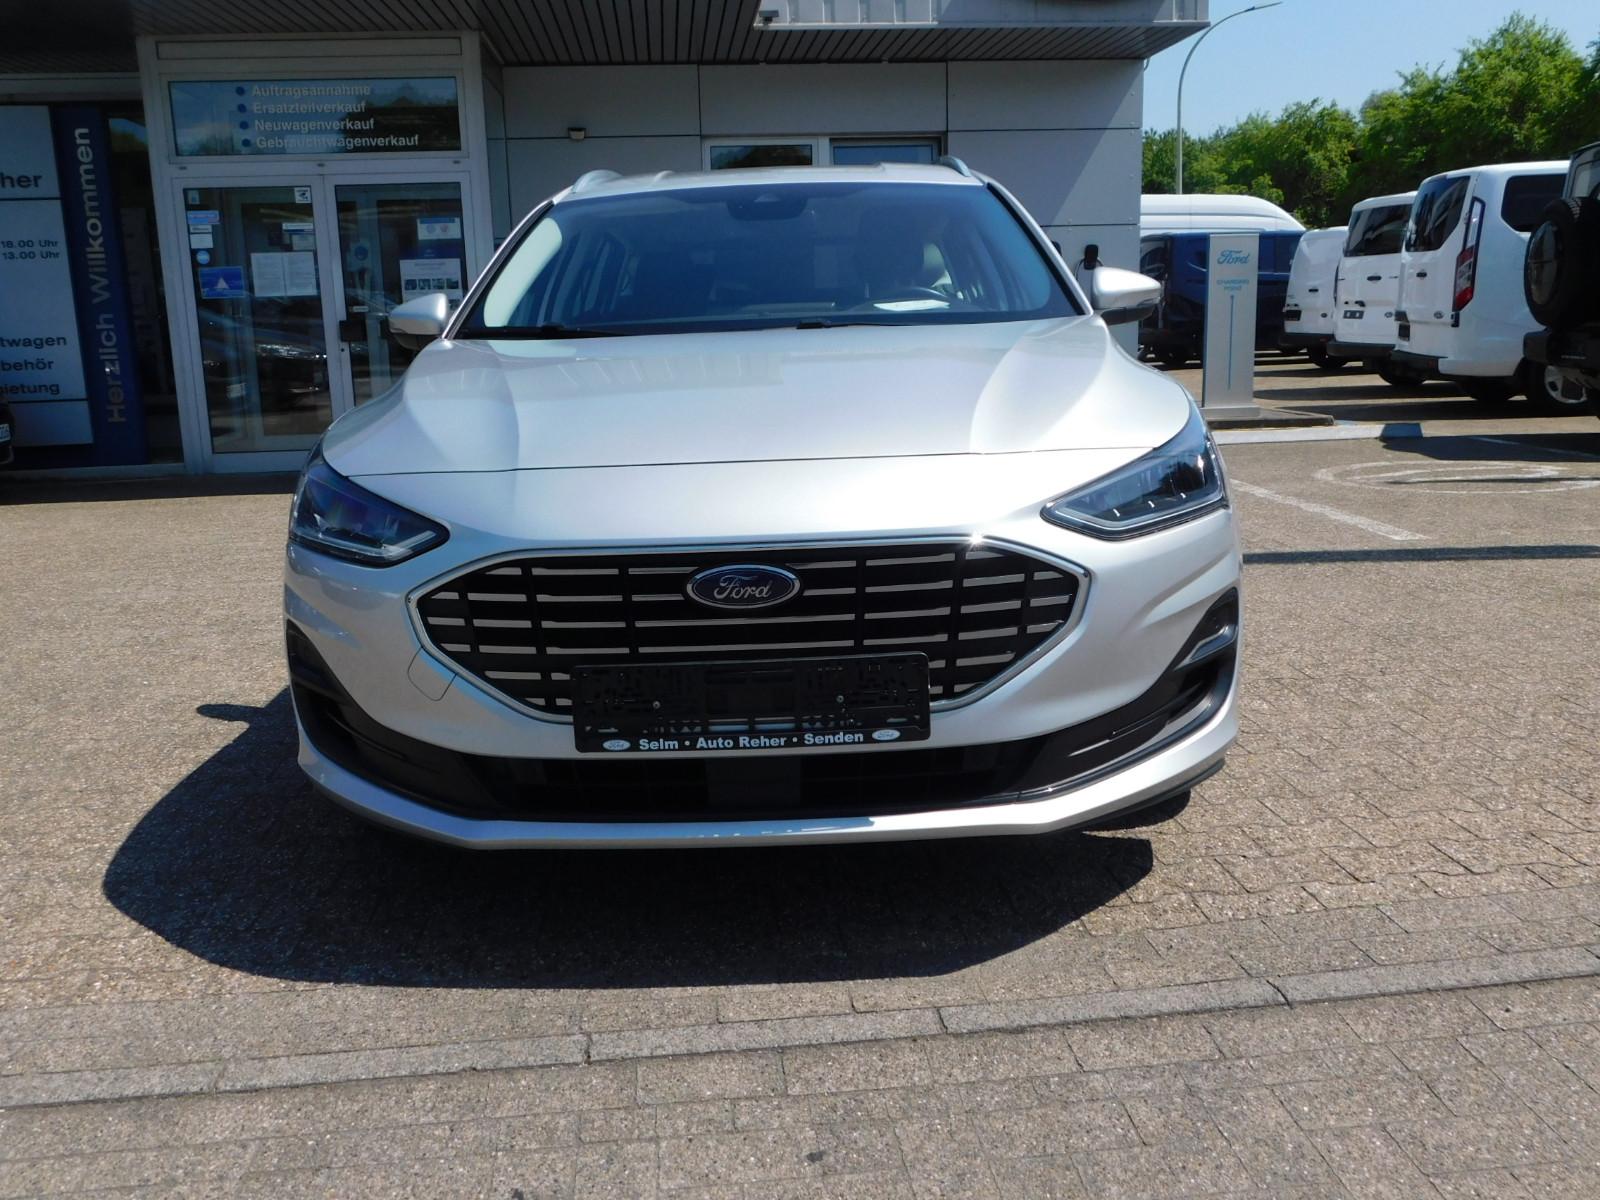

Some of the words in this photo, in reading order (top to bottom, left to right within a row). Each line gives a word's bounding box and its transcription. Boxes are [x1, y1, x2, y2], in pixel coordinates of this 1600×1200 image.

[252, 83, 371, 98] Auftragsannahme
[253, 101, 367, 114] Ersatzteilverkauf
[254, 118, 375, 133] Neuwagenverkauf
[256, 134, 420, 149] Gebrauchtwagenverkauf
[74, 127, 112, 304] Willkommen
[39, 240, 58, 248] Uhr
[40, 250, 60, 259] Uhr
[1217, 249, 1250, 265] Ford
[96, 313, 127, 422] Herzlich
[713, 574, 774, 600] Ford
[639, 738, 679, 750] Selm
[696, 737, 734, 749] Auto
[739, 735, 788, 748] Reher
[804, 732, 864, 745] Senden
